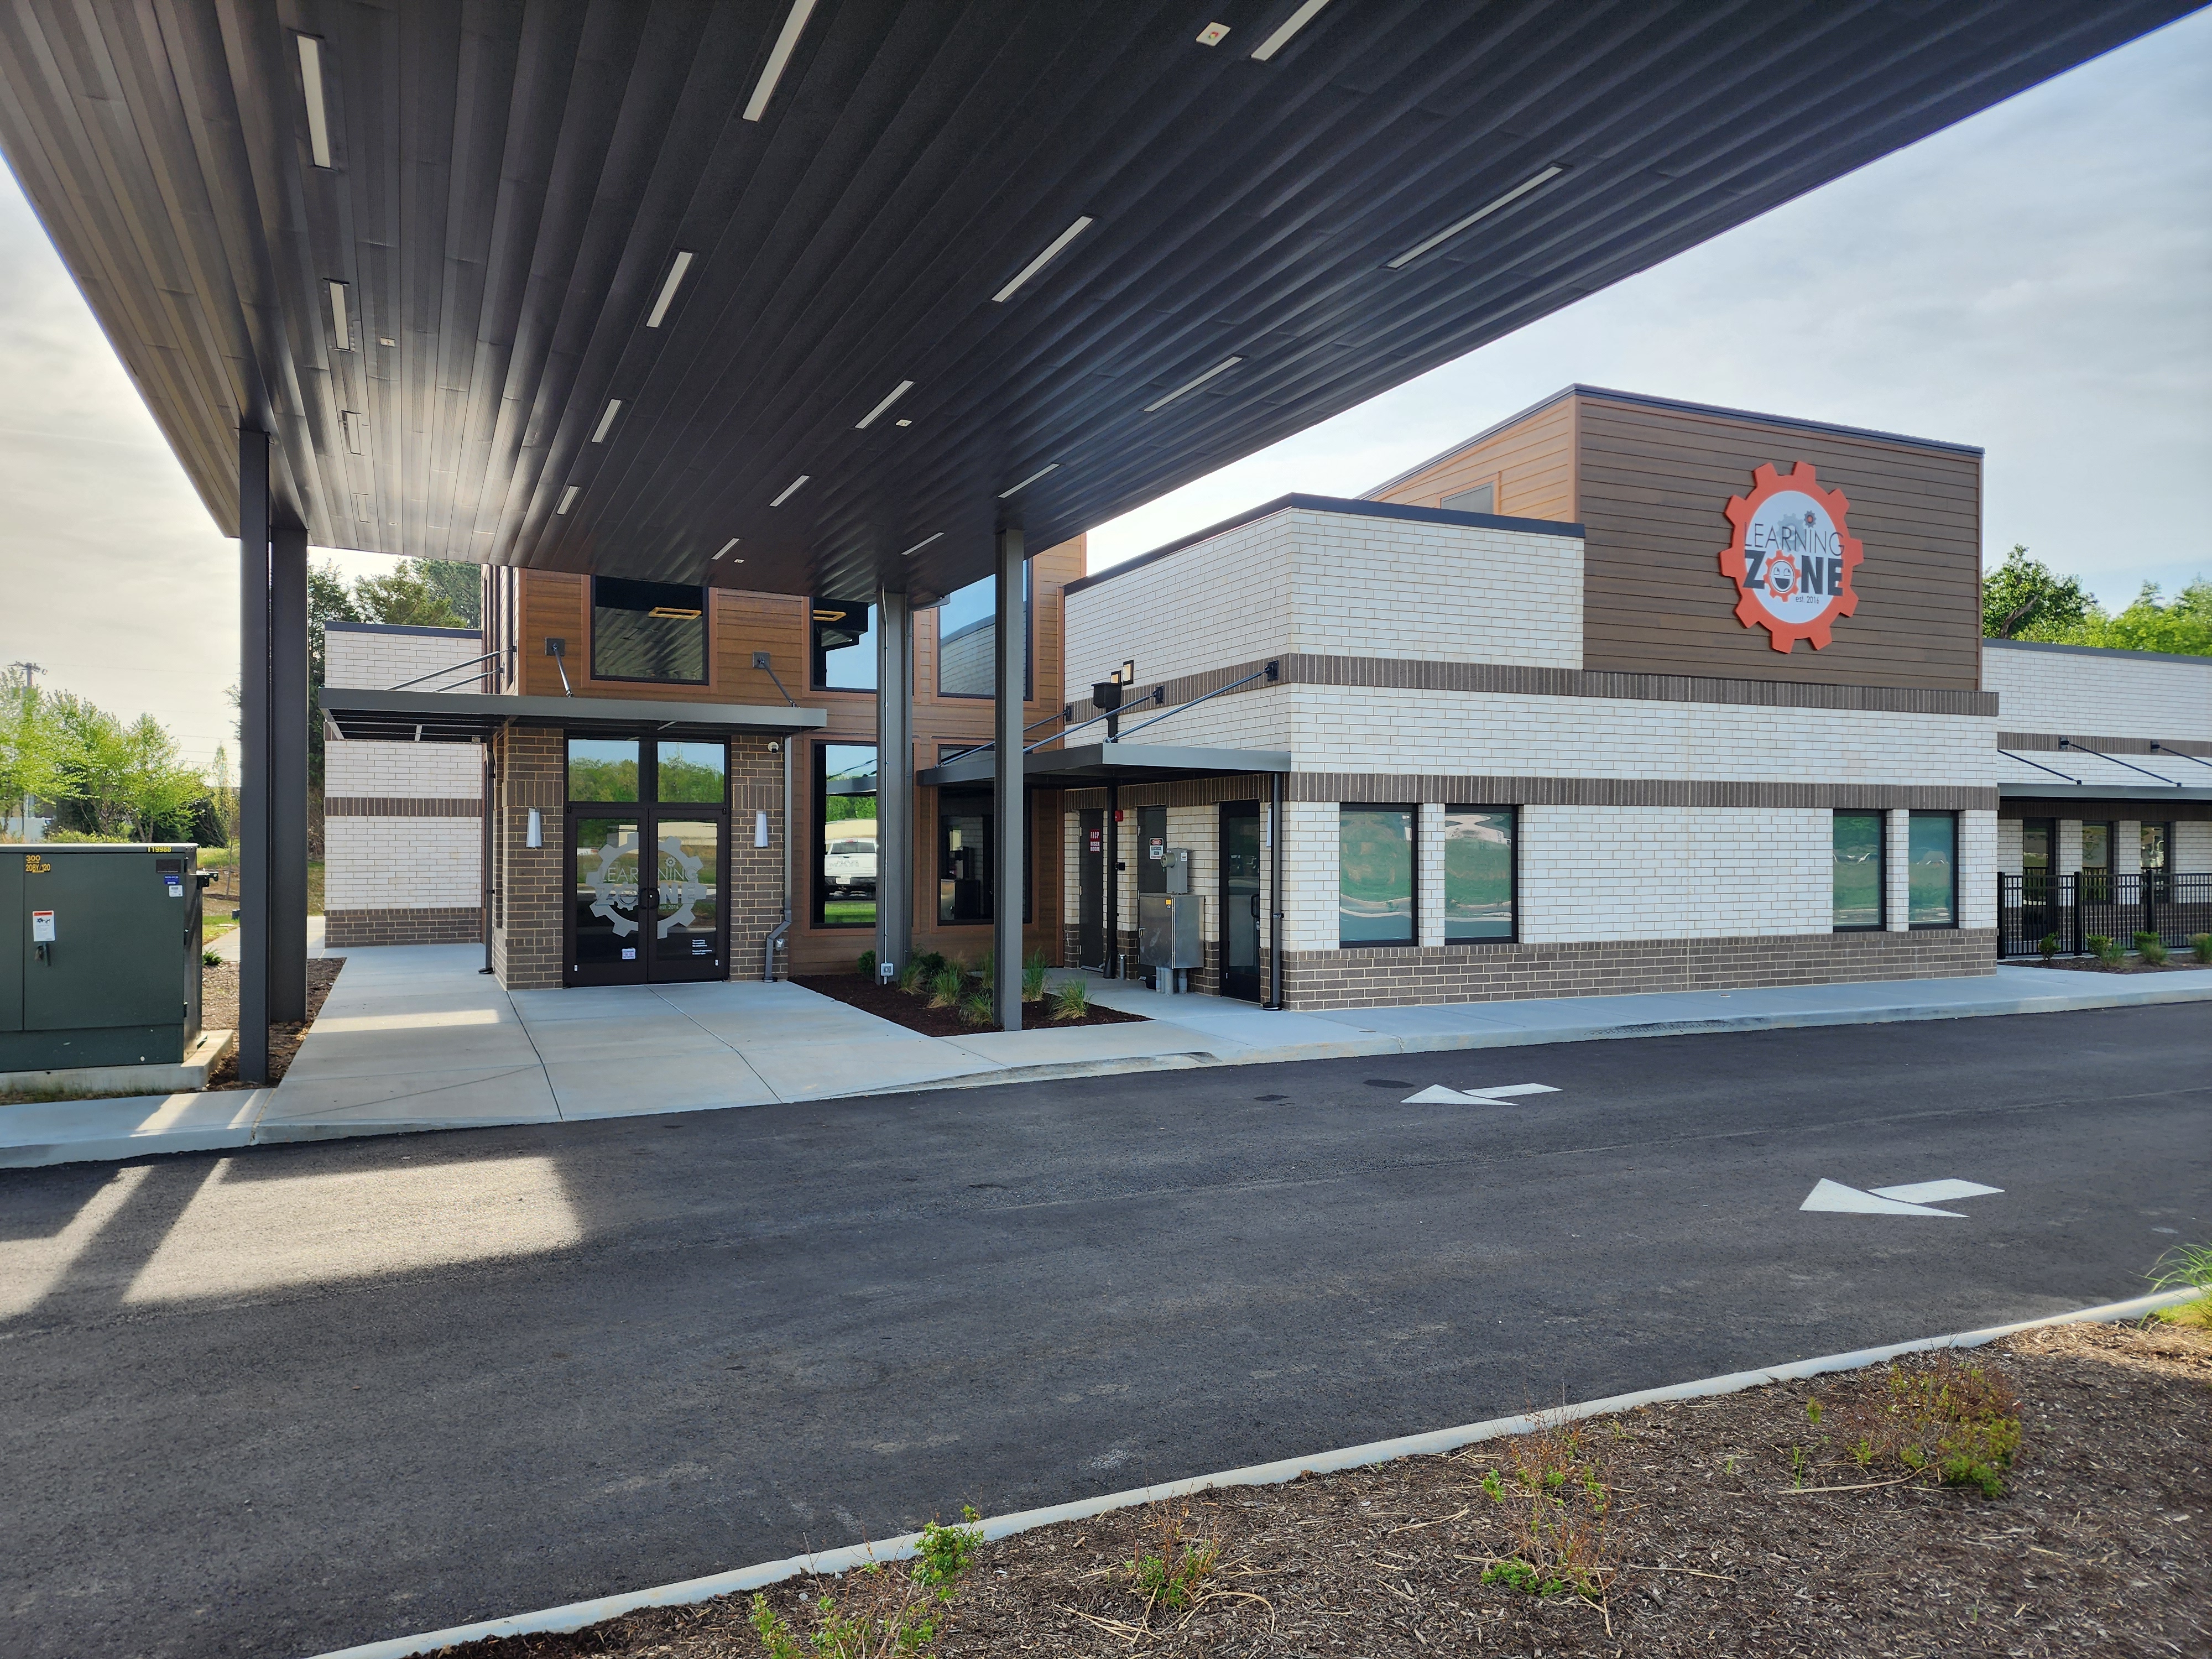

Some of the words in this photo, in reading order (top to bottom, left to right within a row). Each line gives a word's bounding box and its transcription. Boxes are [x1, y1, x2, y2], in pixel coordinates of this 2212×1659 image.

[1745, 521, 1845, 556] LEARNING
[1743, 549, 1844, 597] ZONE
[1807, 596, 1820, 604] 2016
